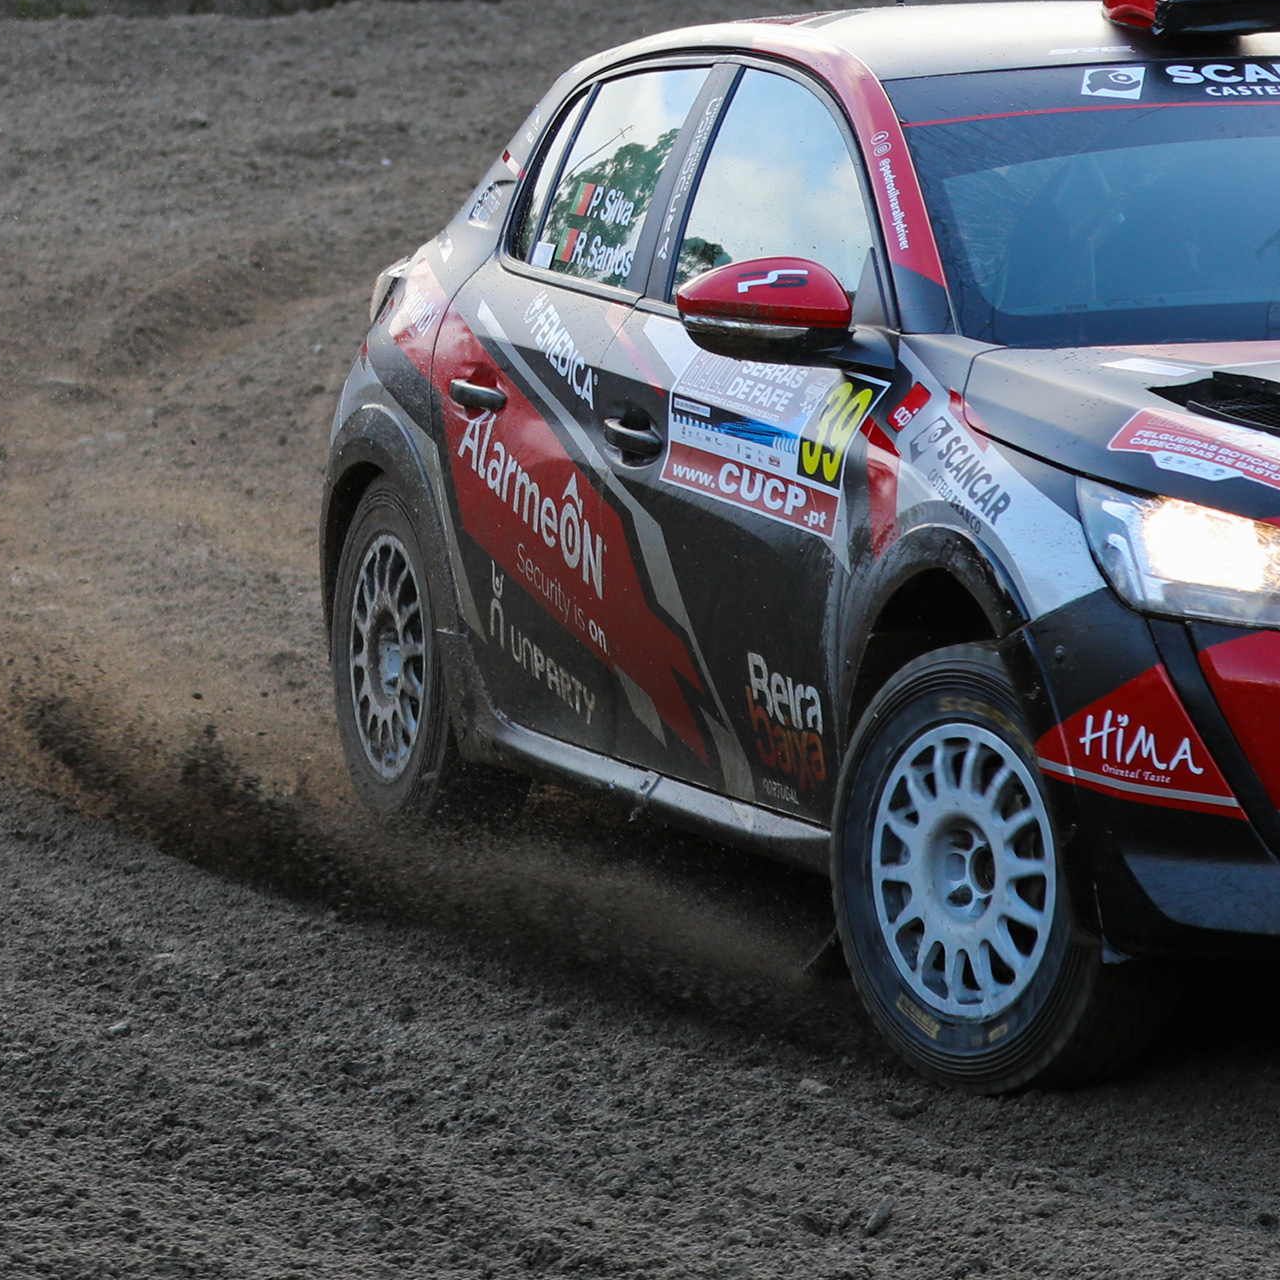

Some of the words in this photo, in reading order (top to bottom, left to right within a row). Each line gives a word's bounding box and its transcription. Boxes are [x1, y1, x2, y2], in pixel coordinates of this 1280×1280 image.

[586, 186, 605, 218] P.
[601, 188, 635, 226] Silva
[879, 158, 910, 250] @pedrosilvarallydriver
[571, 232, 587, 265] R.
[587, 235, 634, 277] Santos
[531, 304, 595, 410] FEMEDICA
[742, 361, 808, 389] SERRAS
[725, 376, 755, 400] DE
[748, 383, 794, 412] FAFE
[801, 381, 874, 482] 39
[1129, 437, 1217, 462] CABECEIRAS
[1214, 455, 1236, 466] DE
[1134, 428, 1221, 453] FELGUEIRAS
[1219, 447, 1280, 474] BOTICAS
[672, 462, 828, 529] www.CUCP.pt
[927, 468, 954, 503] CASTELO
[949, 494, 982, 535] BRANCO
[937, 435, 1012, 526] SCANCAR
[517, 543, 571, 624] Security
[574, 596, 586, 631] is
[762, 775, 801, 806] PORTUGAL
[1101, 763, 1141, 779] Oriental
[1142, 771, 1172, 784] Taste
